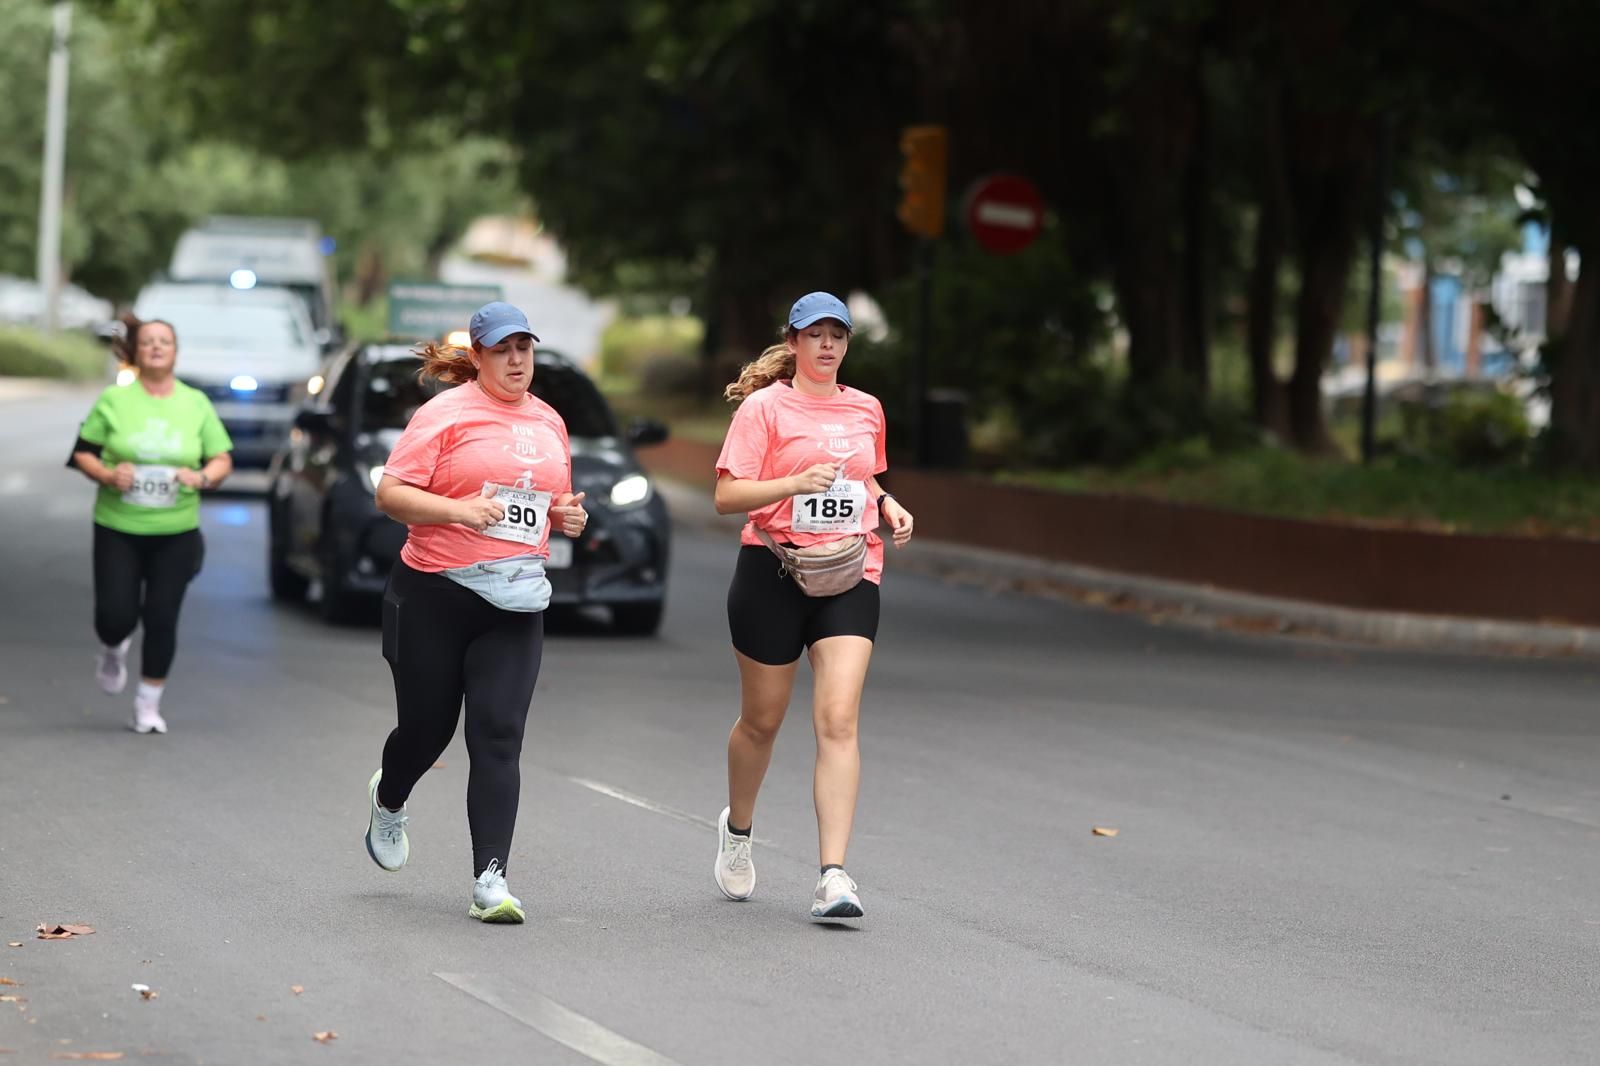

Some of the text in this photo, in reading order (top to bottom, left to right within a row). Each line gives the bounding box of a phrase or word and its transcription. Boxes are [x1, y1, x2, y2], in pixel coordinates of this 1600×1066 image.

[512, 424, 534, 437] RUN
[516, 442, 537, 456] FUN
[829, 438, 849, 449] FUN
[804, 498, 854, 518] 185
[502, 504, 537, 527] 90
